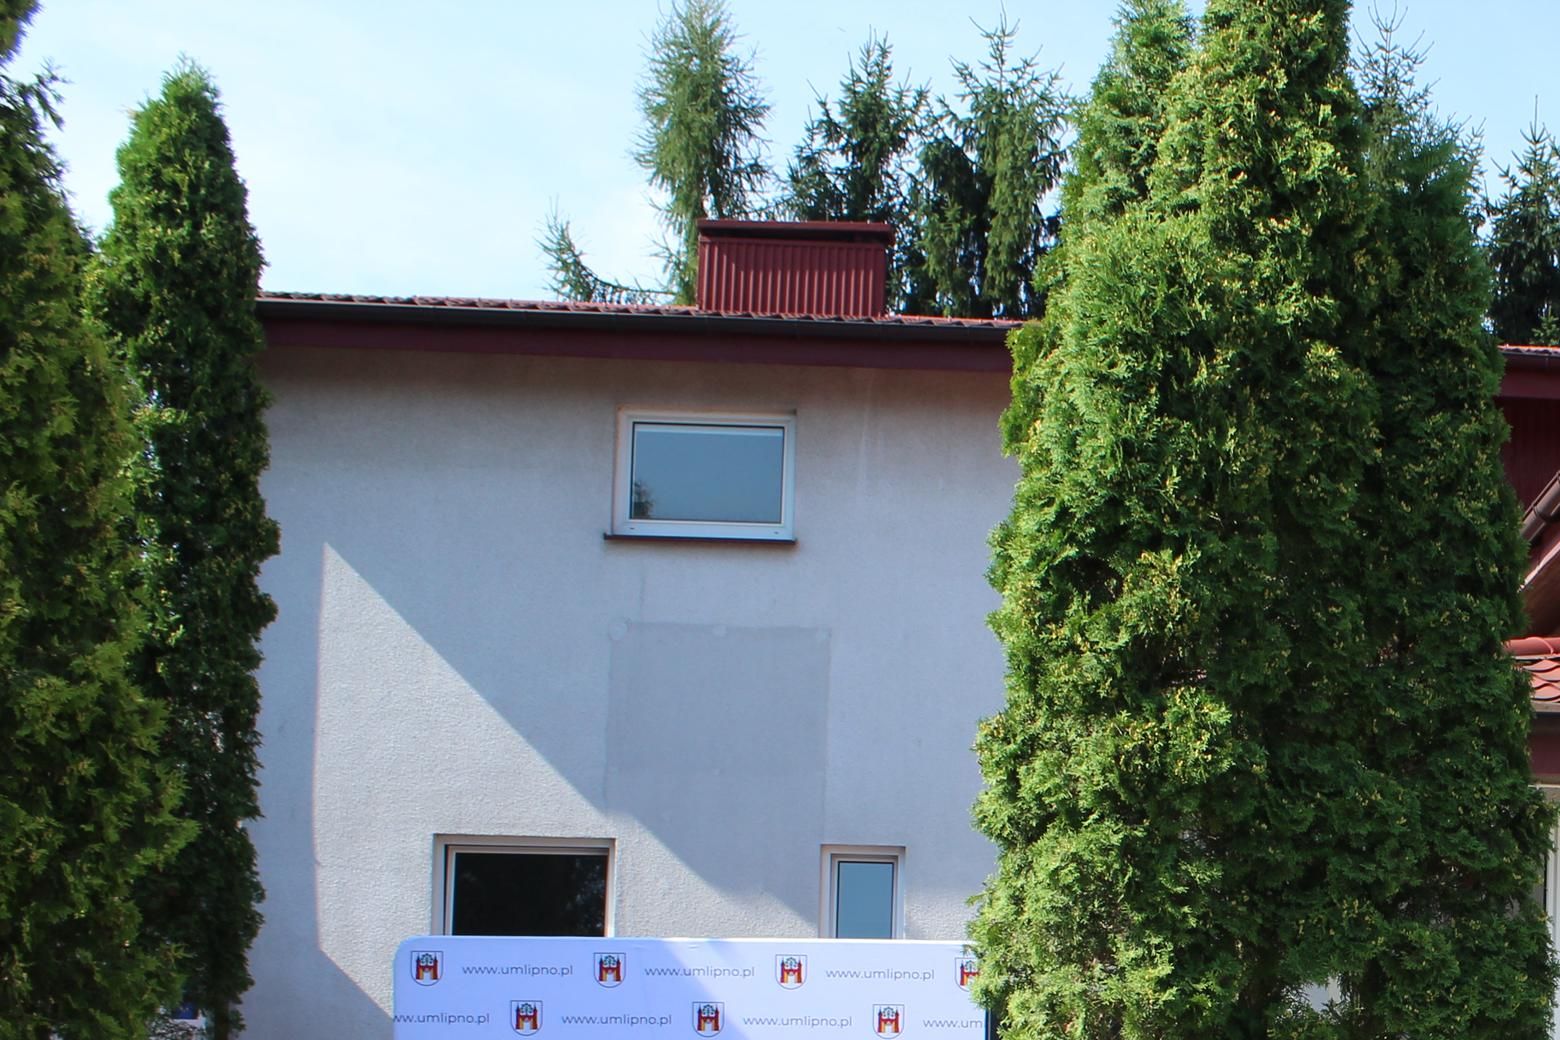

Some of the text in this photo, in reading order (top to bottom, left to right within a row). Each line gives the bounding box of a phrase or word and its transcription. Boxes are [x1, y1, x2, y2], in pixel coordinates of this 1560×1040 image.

[462, 964, 573, 978] www.umlipno.pl
[644, 965, 755, 979] www.umlipno.pl
[826, 967, 935, 981] www.umlipno.pl
[561, 1012, 672, 1026] www.umlipno.pl
[743, 1014, 853, 1028] www.umlipno.pl
